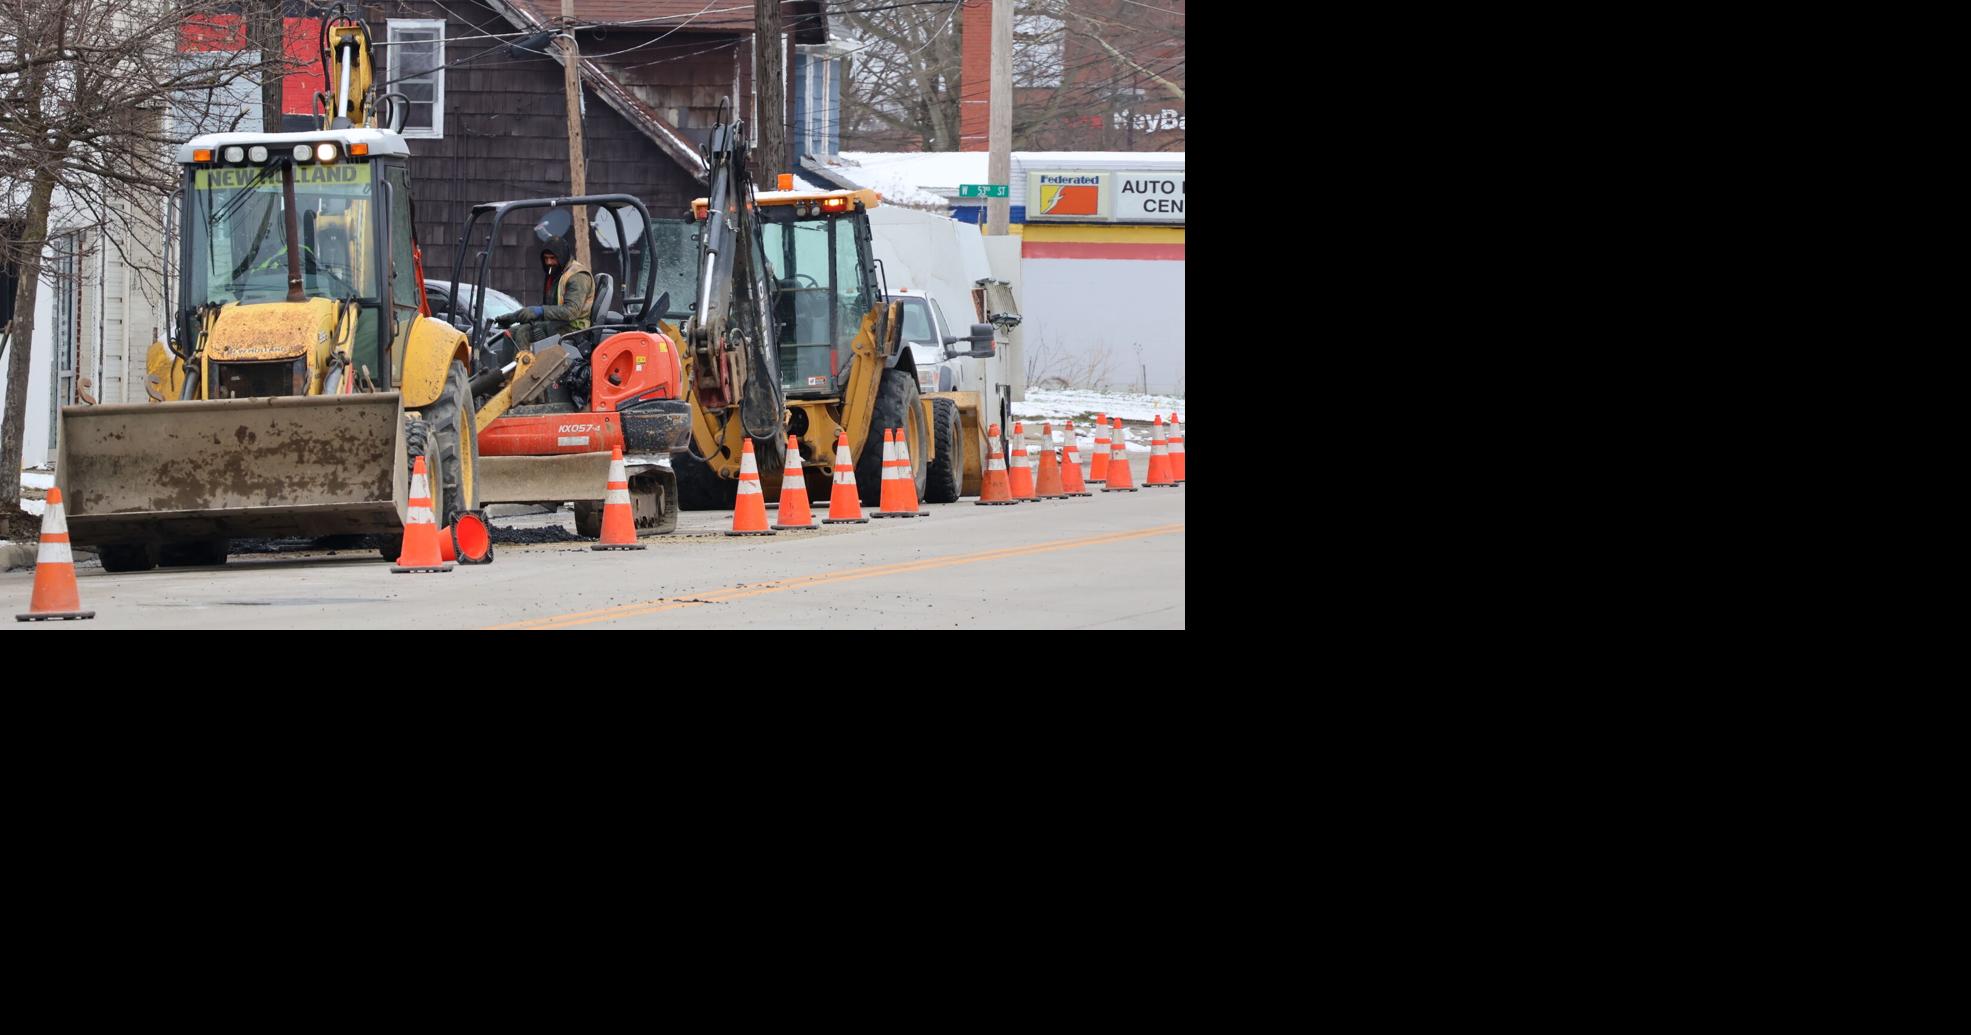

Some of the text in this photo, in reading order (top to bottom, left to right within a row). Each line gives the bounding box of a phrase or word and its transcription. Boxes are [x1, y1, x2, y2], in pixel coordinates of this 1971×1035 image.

[210, 168, 256, 187] NEW
[1041, 175, 1099, 186] Federated
[962, 185, 969, 196] W
[997, 186, 1006, 196] ST
[1121, 180, 1175, 194] AUTO
[1143, 199, 1184, 213] CEN
